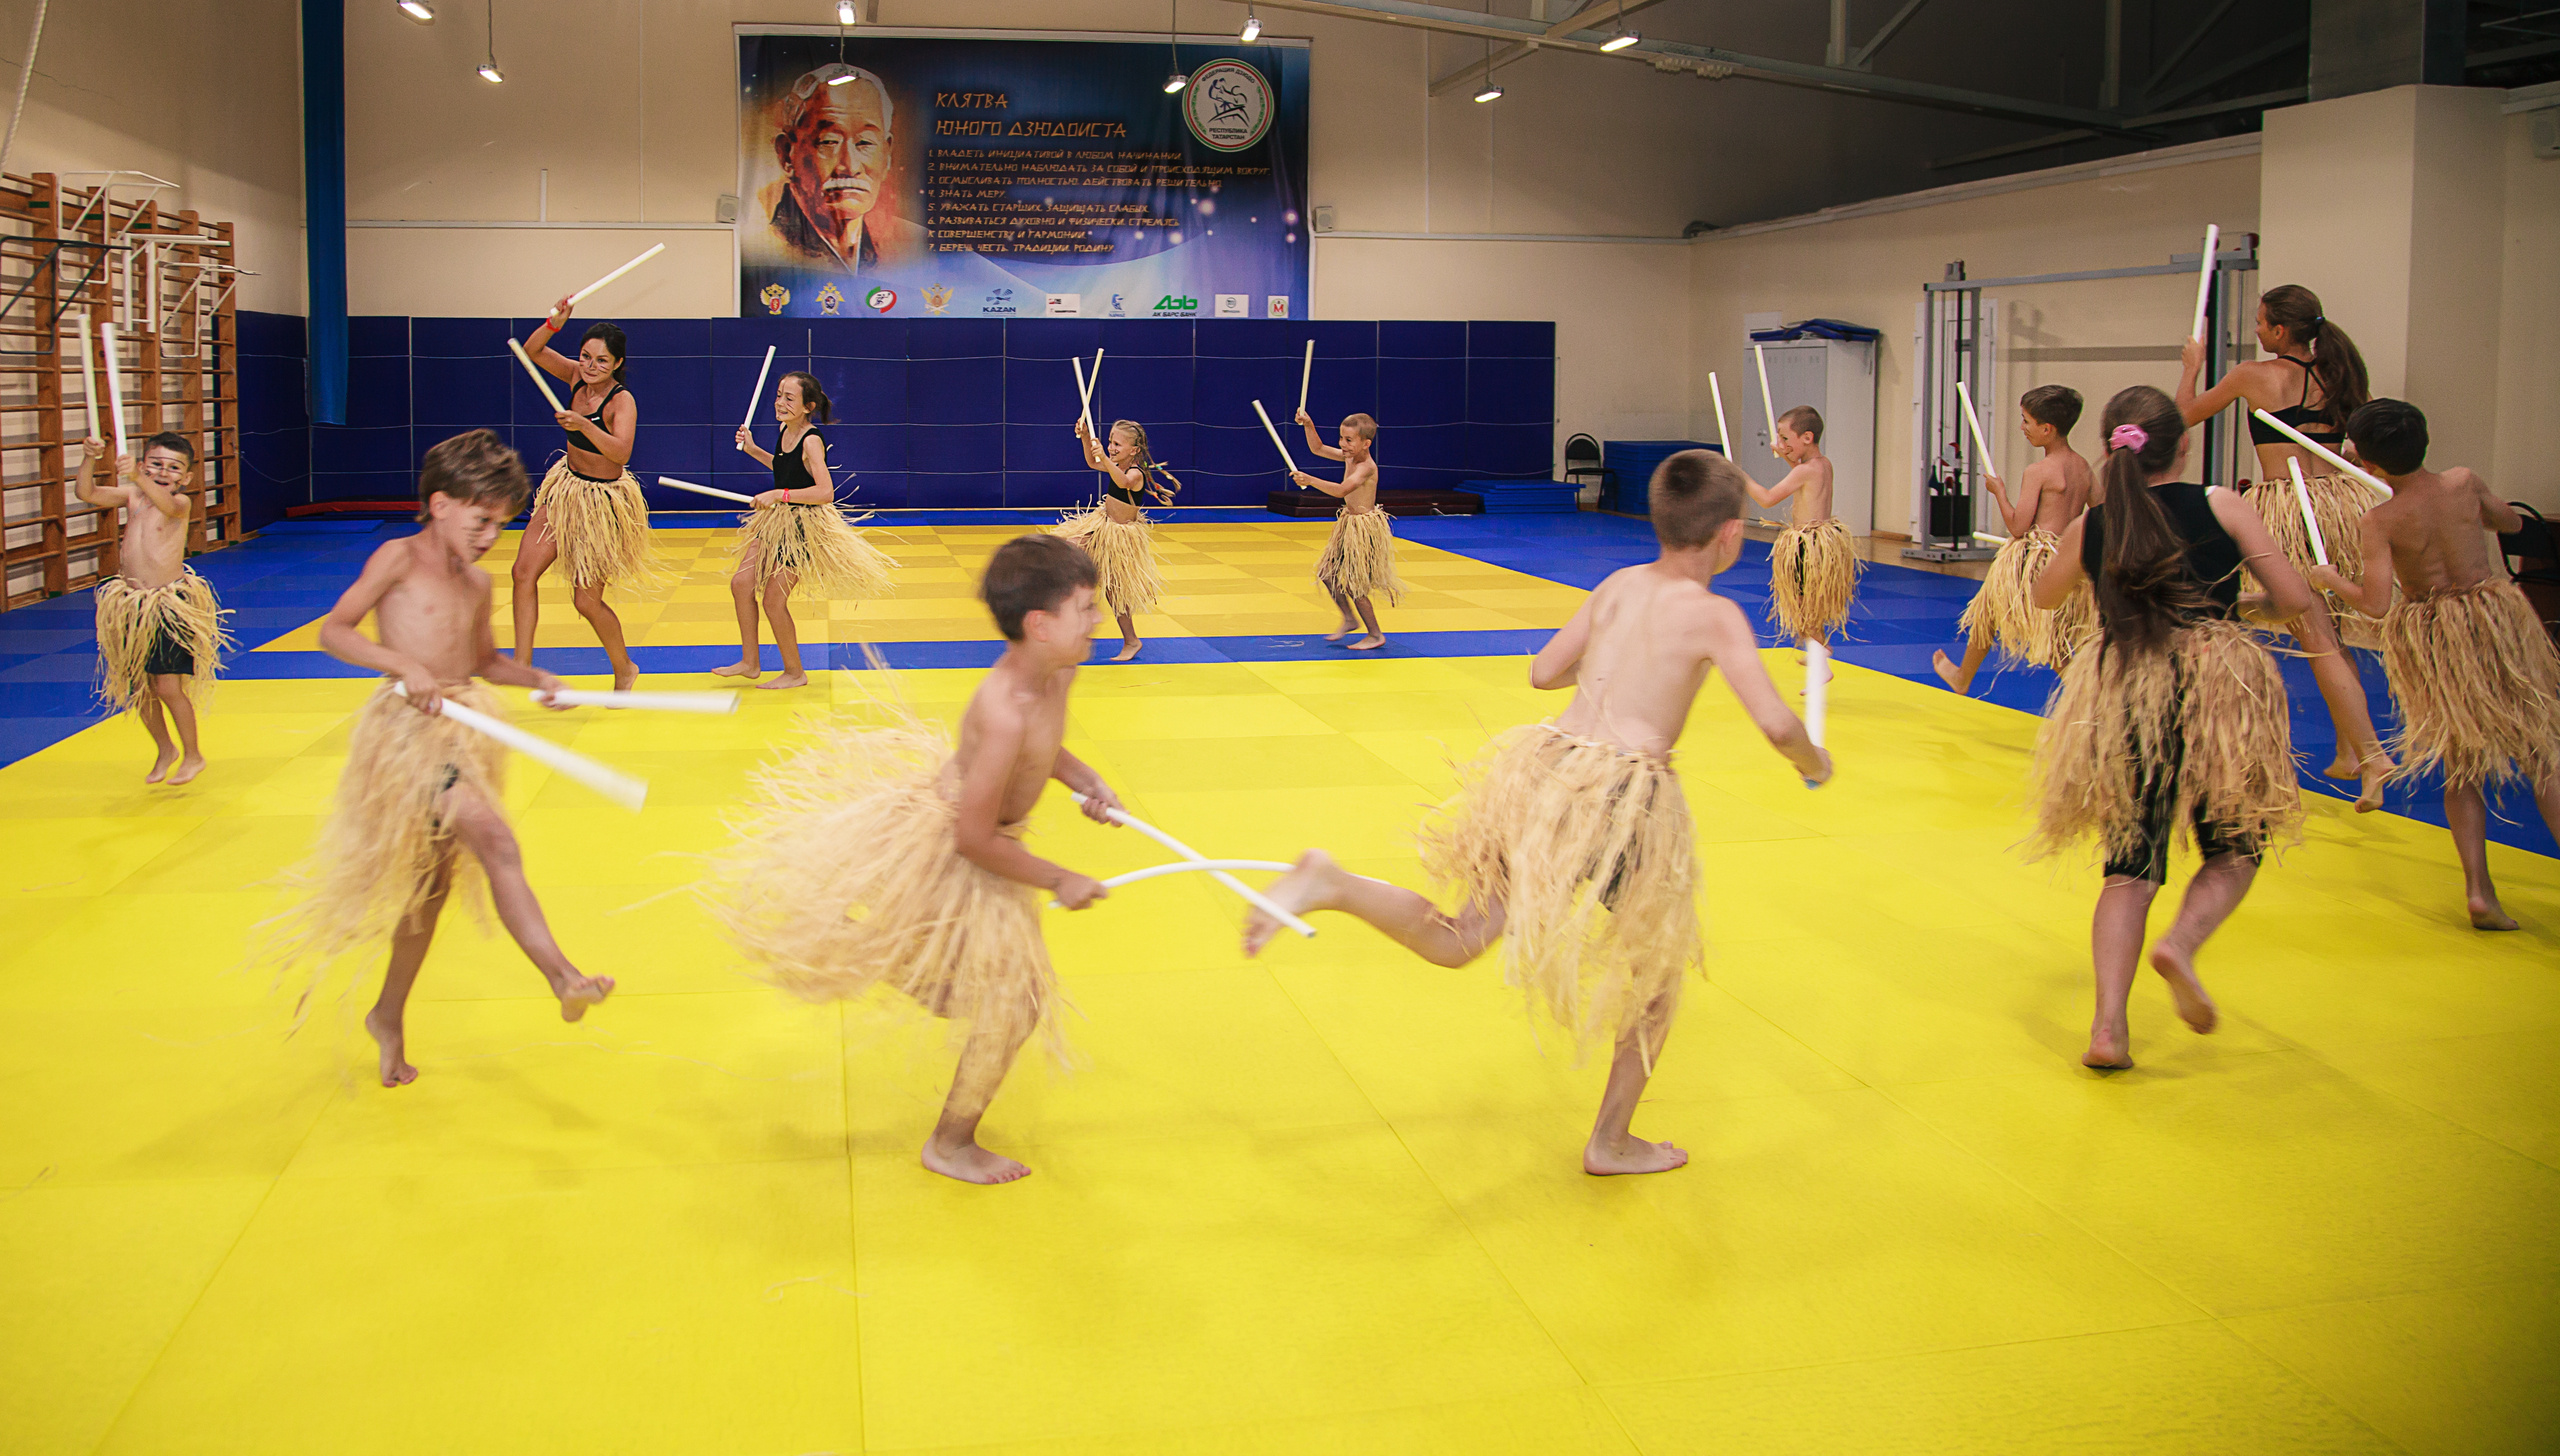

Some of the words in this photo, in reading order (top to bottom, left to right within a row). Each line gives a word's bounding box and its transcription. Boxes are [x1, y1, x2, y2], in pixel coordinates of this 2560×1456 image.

[935, 92, 1008, 109] КЛЯТВА
[936, 120, 1001, 136] ЮНОГО
[1008, 121, 1127, 138] ДЗЮДОИСТА
[937, 149, 985, 158] ВЛАДЕТЬ
[988, 149, 1064, 161] ИНИЦИАТИВОЙ
[1067, 150, 1073, 159] В
[1075, 150, 1114, 160] ЛЮБОМ
[939, 162, 1018, 172] ВНИМАТЕЛЬНО
[1021, 163, 1088, 173] НАБЛЮДАТЬ
[1090, 164, 1105, 173] ЗА
[1107, 163, 1138, 174] СОБОЙ
[1140, 165, 1148, 174] И
[1151, 165, 1233, 176] ПРОИСХОДЯЩИМ
[938, 175, 1013, 185] ОСМЫСЛИВАТЬ
[1082, 175, 1152, 187] ДЕЙСТВОВАТЬ
[938, 189, 973, 198] ЗНАТЬ
[939, 202, 990, 212] УВАЖАТЬ
[1046, 203, 1107, 215] ЗАЩИЩАТЬ
[939, 216, 1008, 226] РАЗВИВАТЬСЯ
[1009, 216, 1056, 226] ДУХОВНО
[1057, 217, 1066, 226] И
[1128, 218, 1180, 227] СТРЕМЯСЬ
[927, 229, 936, 239] К
[938, 229, 1015, 239] СОВЕРШЕНСТВУ
[1017, 230, 1026, 239] И
